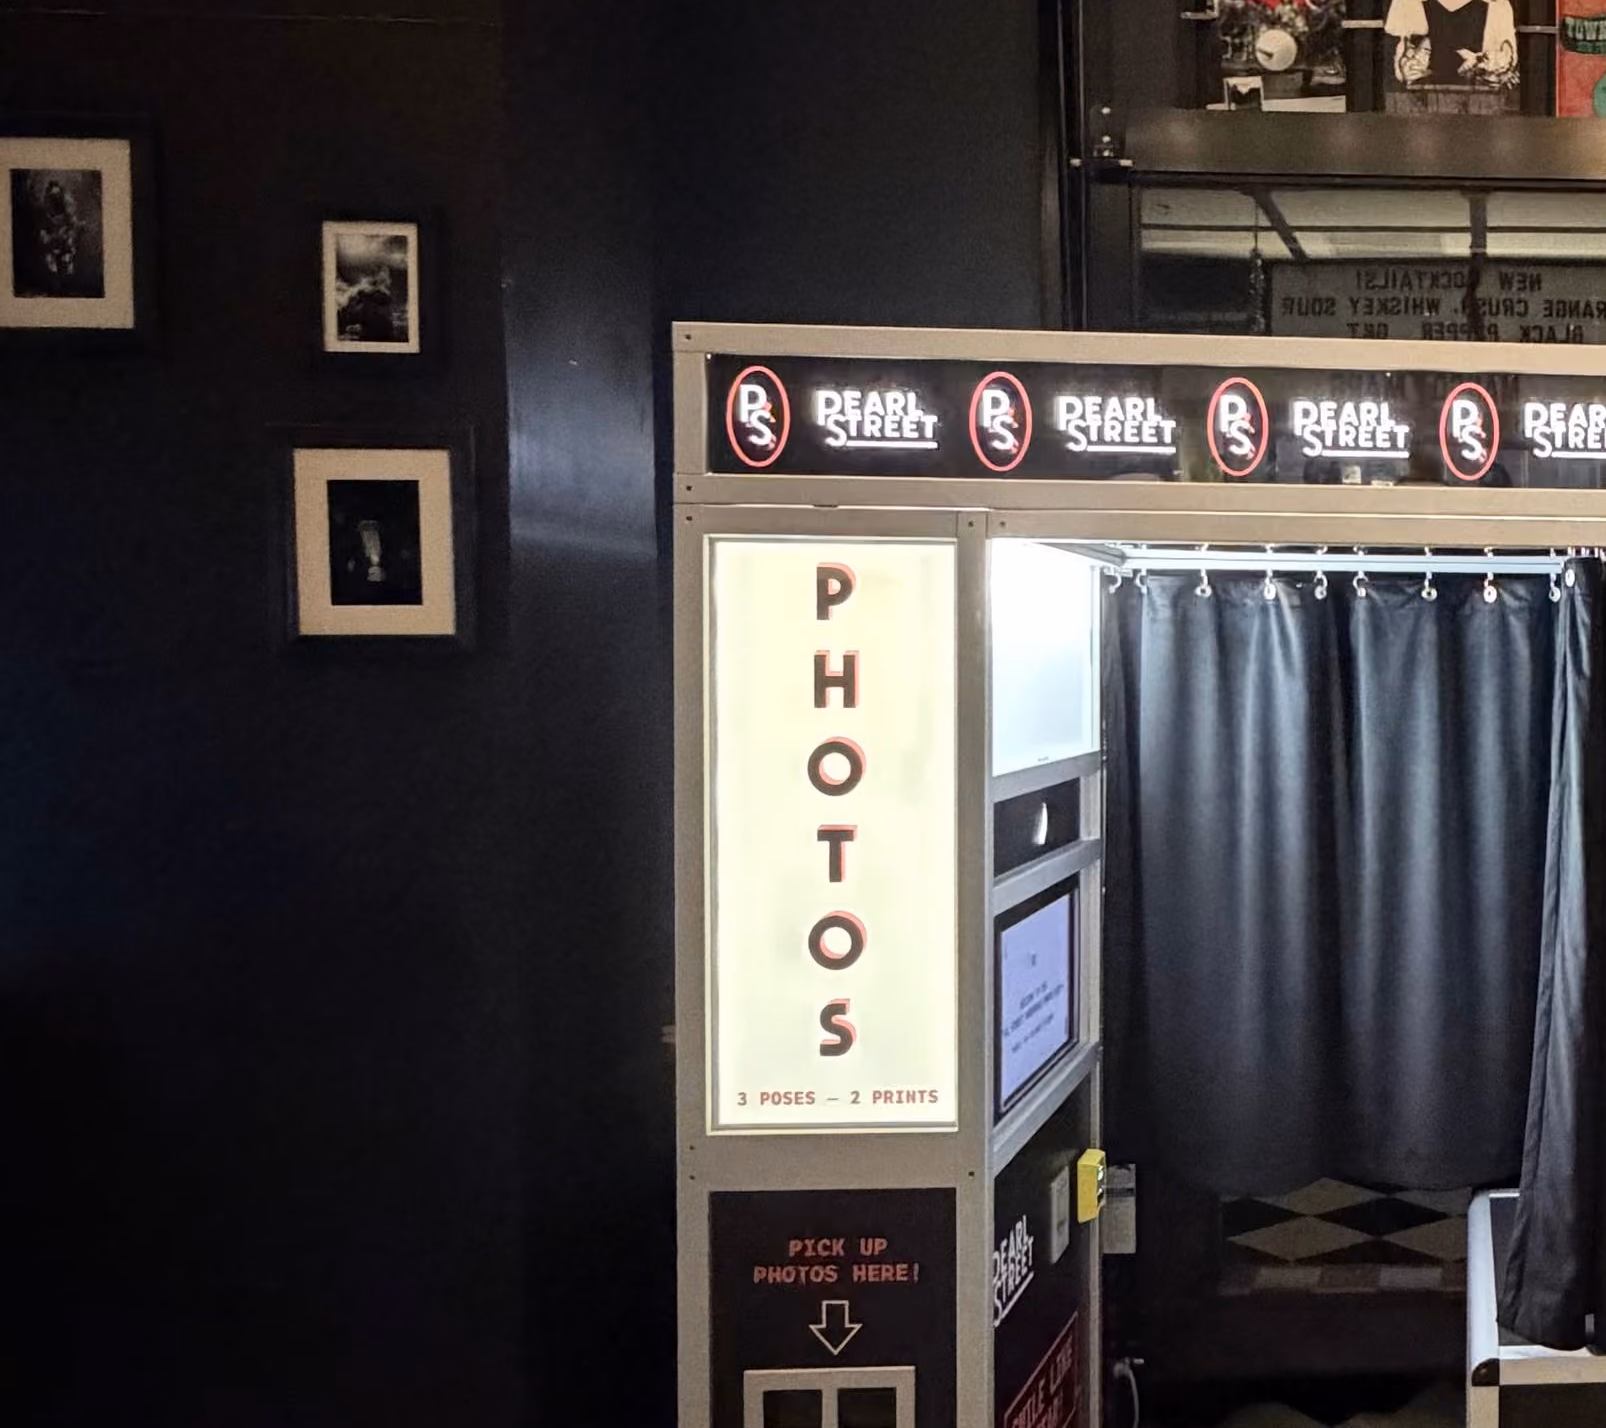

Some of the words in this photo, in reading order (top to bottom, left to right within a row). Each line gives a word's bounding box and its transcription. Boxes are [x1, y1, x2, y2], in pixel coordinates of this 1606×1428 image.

[816, 389, 924, 426] PEARL
[1058, 395, 1162, 432] PEARL
[1293, 401, 1396, 436] PEARL
[825, 414, 938, 448] STREET
[1065, 420, 1177, 453] STREET
[1302, 424, 1410, 459] STREET
[807, 561, 867, 1057] PHOTOS
[736, 1091, 748, 1106] 3
[759, 1090, 816, 1106] POSES
[850, 1090, 862, 1105] 2
[872, 1089, 939, 1105] PRINTS
[788, 1238, 846, 1257] PICK
[859, 1237, 889, 1256] UP
[753, 1264, 839, 1285] PHOTOS
[852, 1262, 920, 1283] HERE!
[992, 1235, 1035, 1328] STREET
